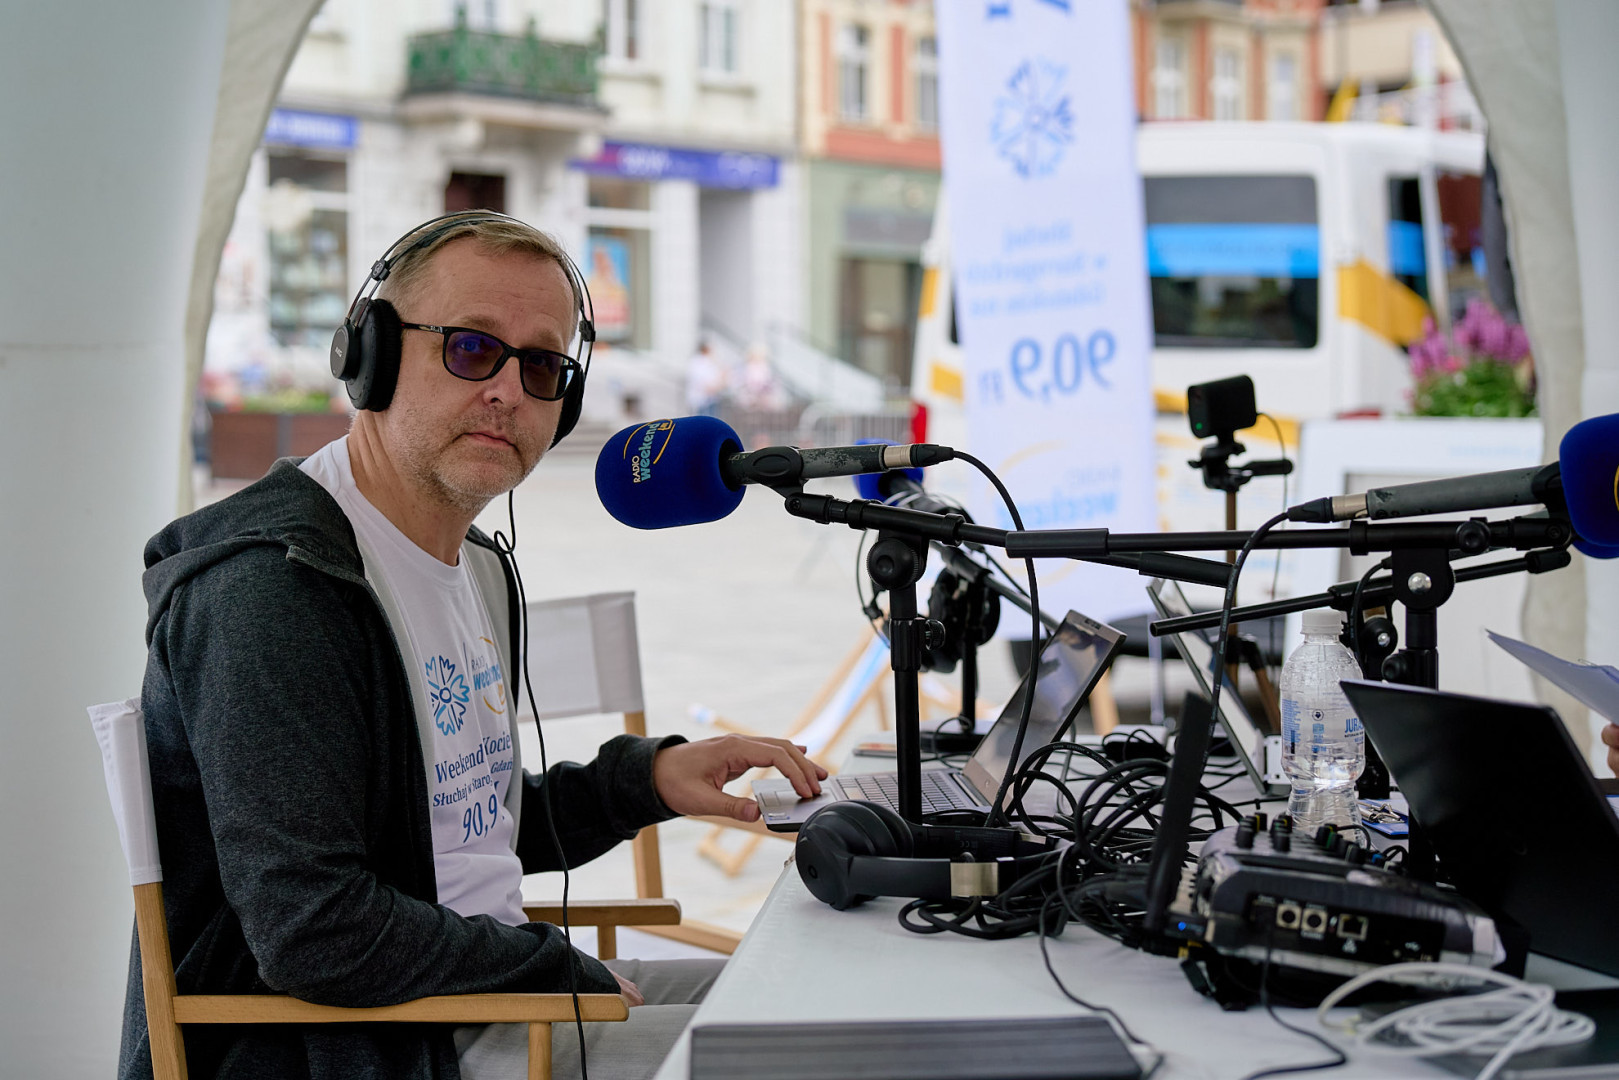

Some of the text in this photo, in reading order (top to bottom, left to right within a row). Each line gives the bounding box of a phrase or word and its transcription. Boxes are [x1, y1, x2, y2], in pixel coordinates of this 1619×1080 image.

[631, 455, 641, 484] RADIO
[638, 422, 661, 482] weekend
[1344, 717, 1364, 734] JURA
[435, 743, 484, 784] Weekend
[433, 784, 468, 807] Słuchaj
[472, 774, 493, 792] Staro
[462, 793, 498, 844] 90,9
